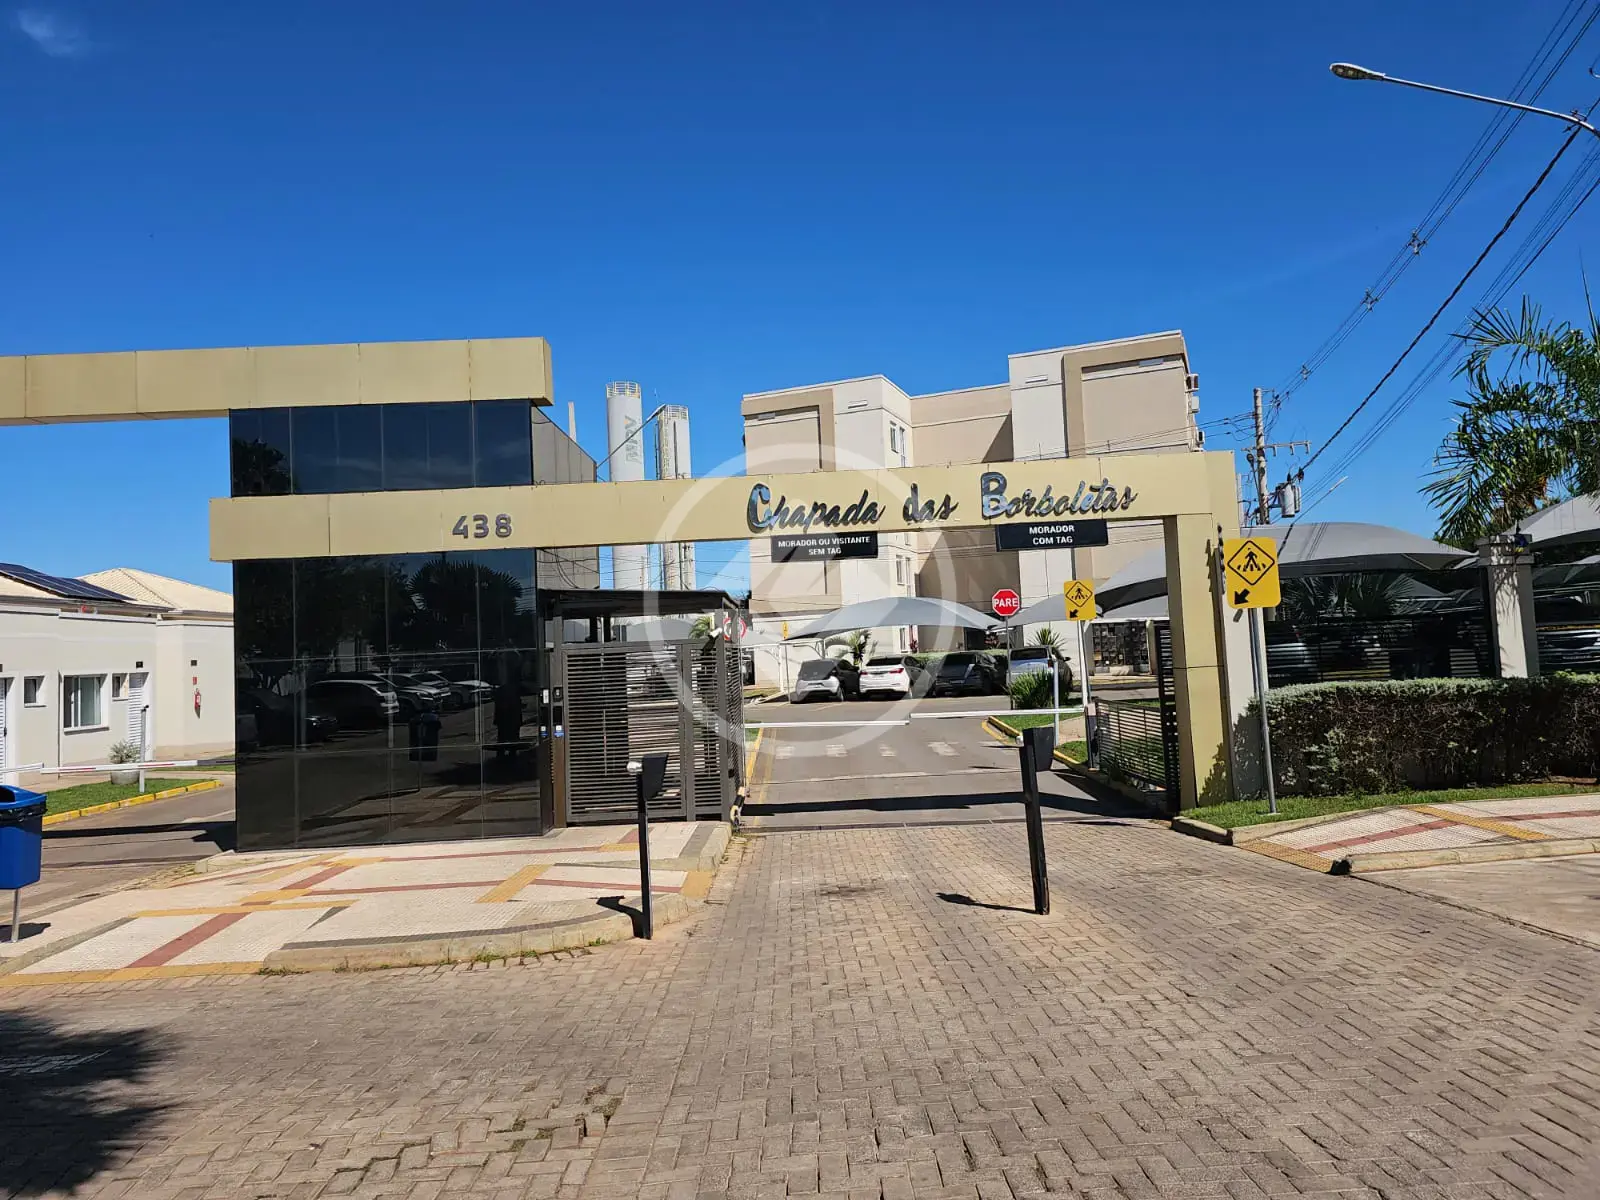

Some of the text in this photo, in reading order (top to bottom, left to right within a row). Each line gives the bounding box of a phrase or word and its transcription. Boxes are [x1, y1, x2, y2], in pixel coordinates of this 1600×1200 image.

[747, 471, 1139, 534] Chapada das Borboletas
[452, 513, 512, 539] 438
[1029, 525, 1075, 534] MORADOR
[778, 536, 871, 547] MORADOR OU VISITANTE
[1033, 536, 1073, 545] COM TAG
[809, 547, 842, 556] SEM TAG
[994, 598, 1019, 607] PARE
